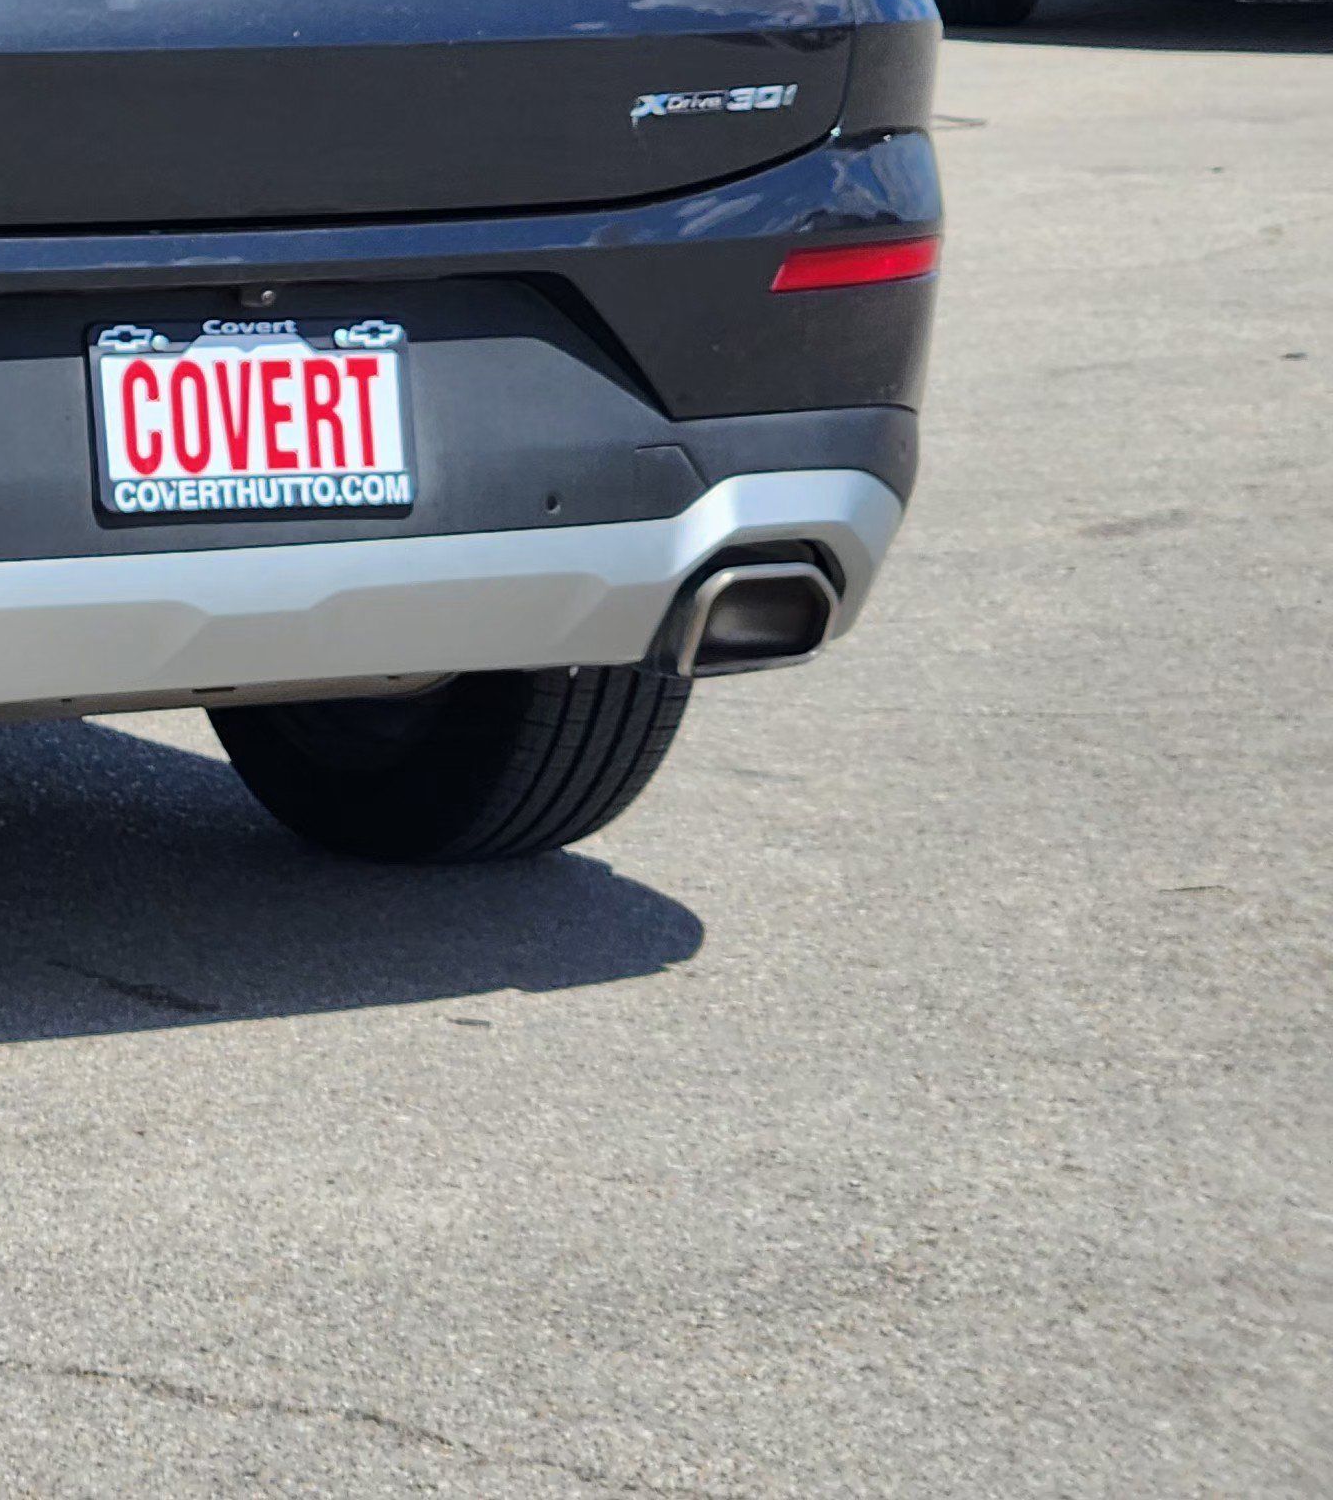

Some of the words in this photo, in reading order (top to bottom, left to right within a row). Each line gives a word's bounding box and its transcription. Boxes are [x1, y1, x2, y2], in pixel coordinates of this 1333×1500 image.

[202, 319, 298, 335] Covert
[121, 357, 380, 475] COVERT
[114, 473, 413, 513] COVERTHUTTO.COM
